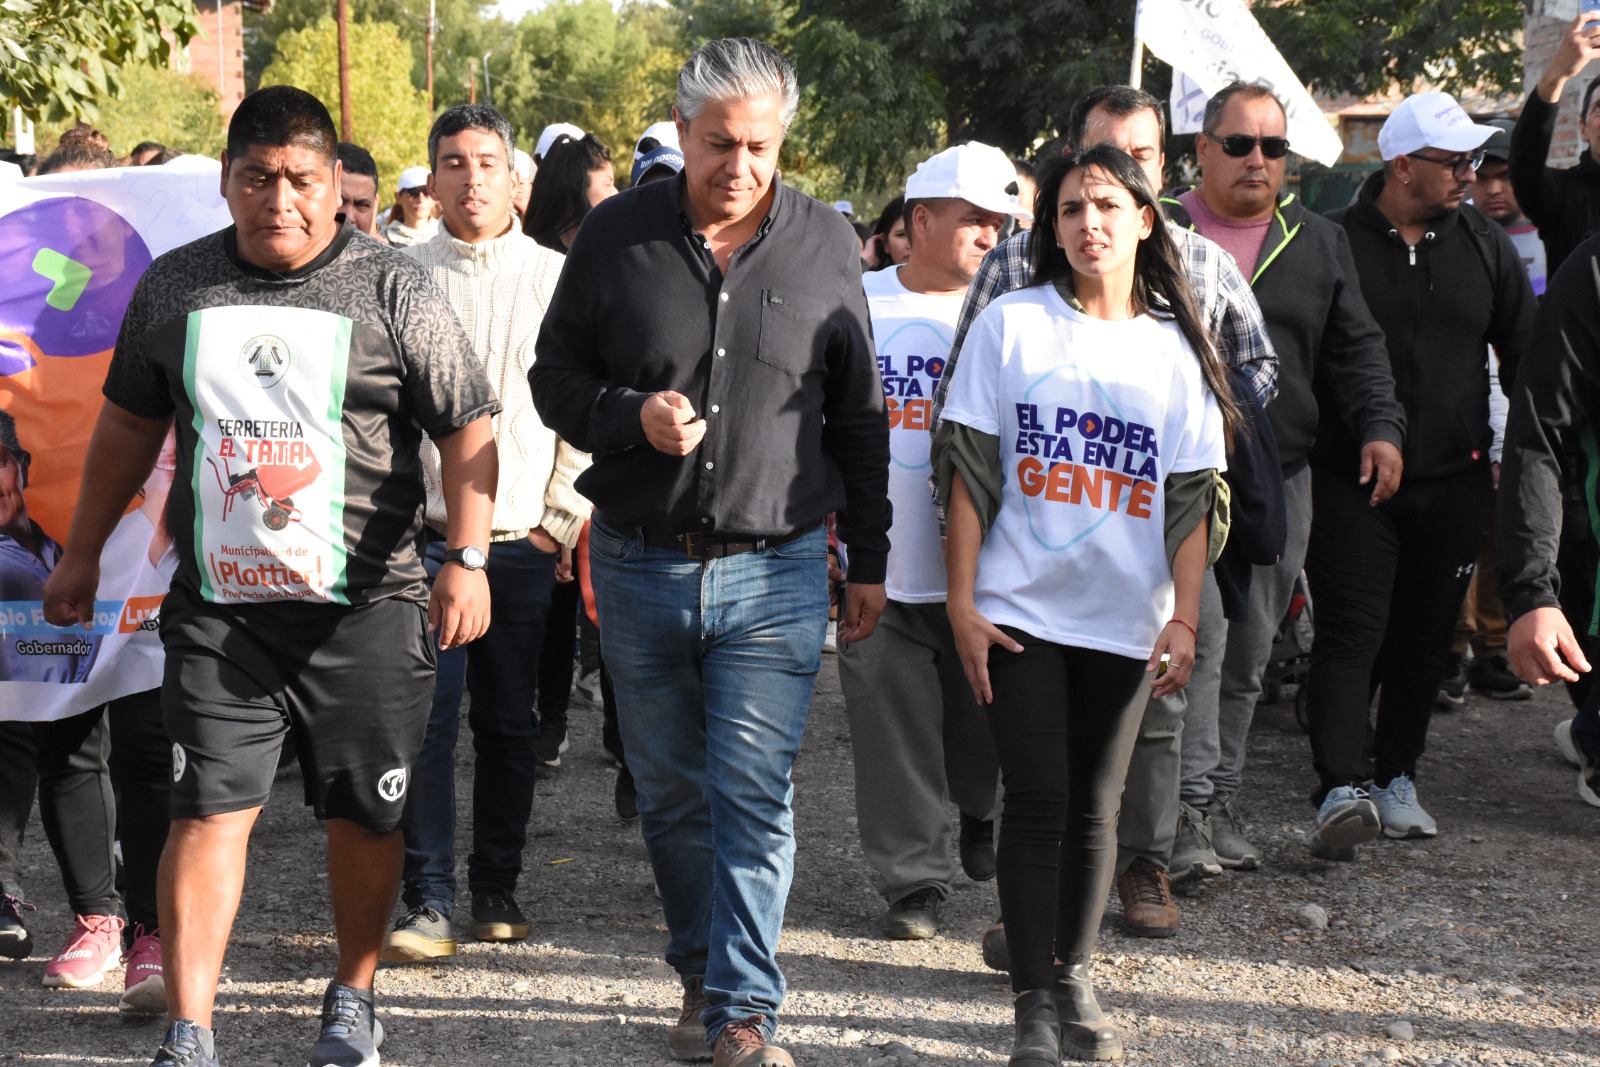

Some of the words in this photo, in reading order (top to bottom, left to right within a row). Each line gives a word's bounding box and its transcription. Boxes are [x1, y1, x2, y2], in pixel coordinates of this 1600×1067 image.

[877, 355, 898, 376] EL
[882, 377, 924, 397] STA
[217, 418, 304, 438] FERRETERIA
[1015, 402, 1044, 431] EL
[1055, 407, 1159, 457] PODER
[218, 438, 237, 458] EL
[244, 440, 304, 463] TATA
[1015, 431, 1073, 461] ESTA
[1083, 441, 1117, 469] EN
[1123, 451, 1158, 483] LA
[1017, 456, 1157, 519] GENTE
[295, 547, 308, 557] de
[15, 639, 92, 657] Gobernador
